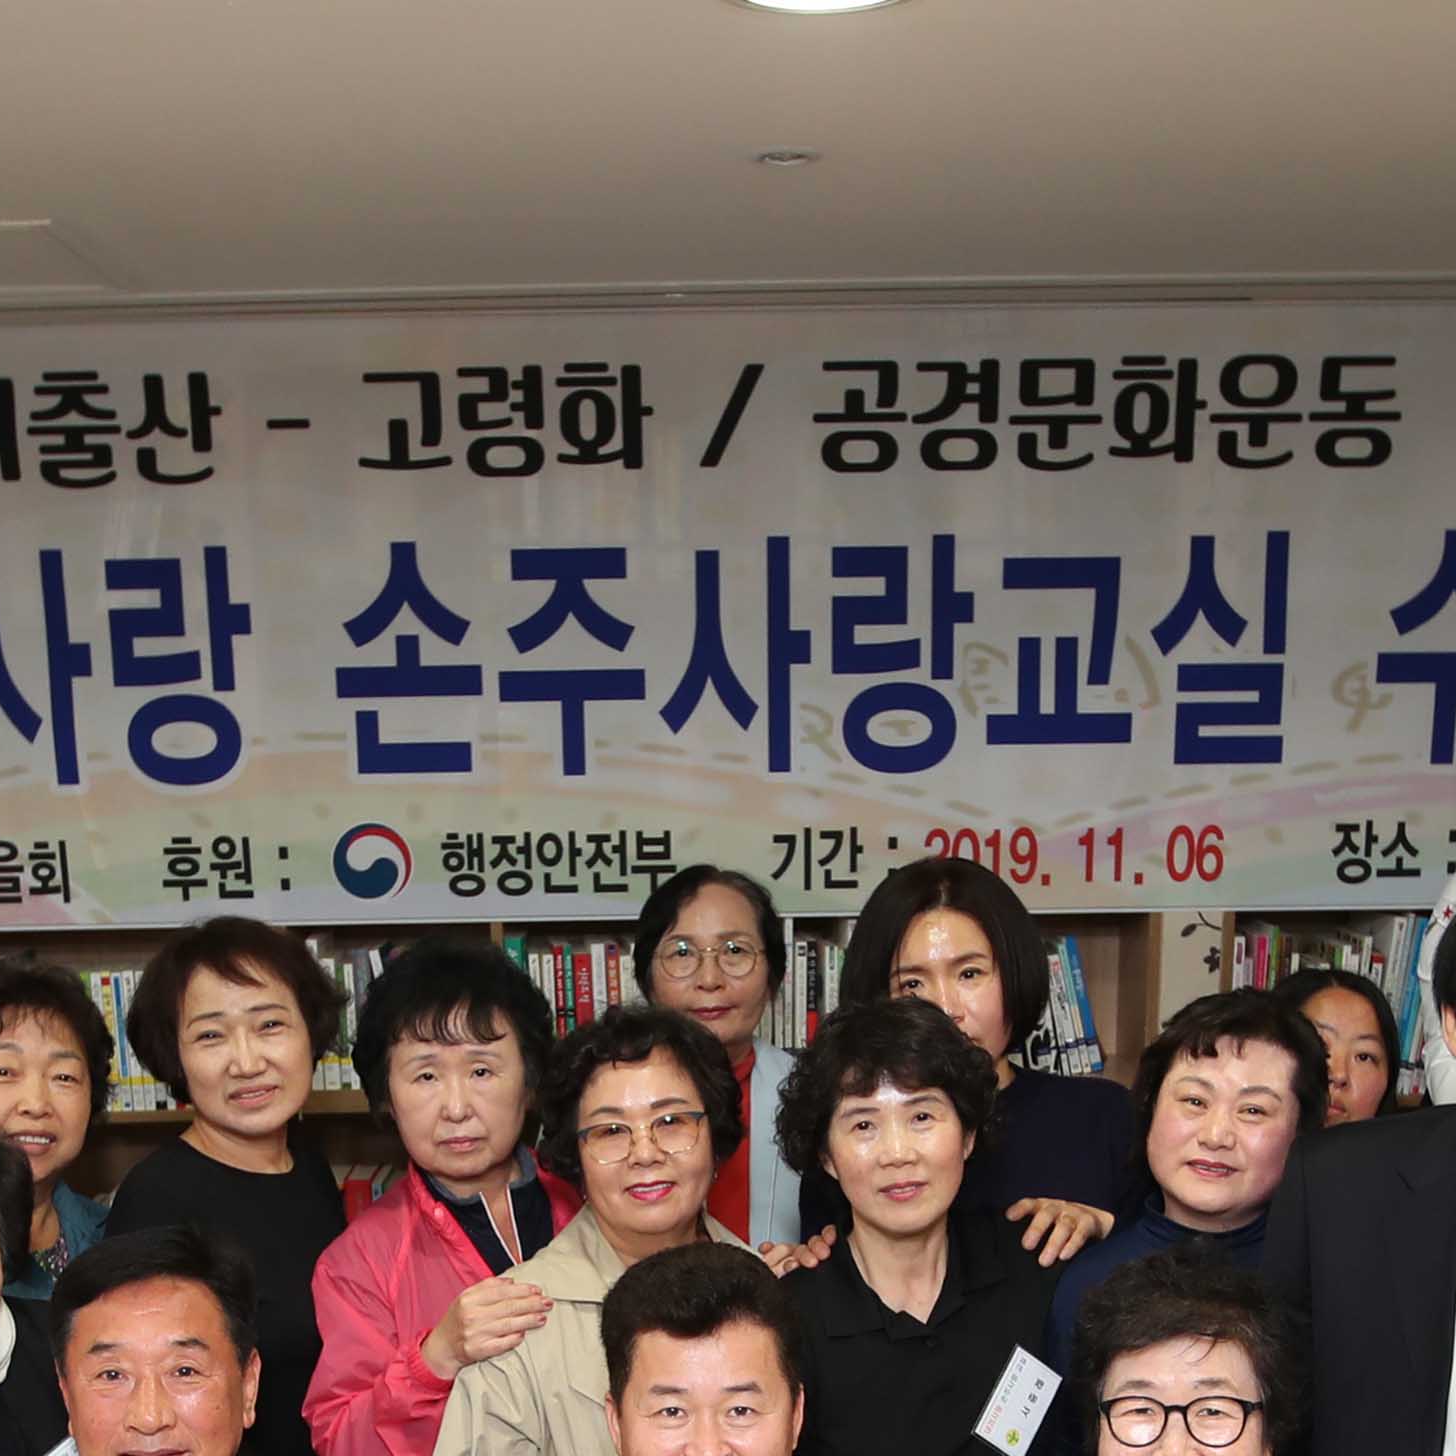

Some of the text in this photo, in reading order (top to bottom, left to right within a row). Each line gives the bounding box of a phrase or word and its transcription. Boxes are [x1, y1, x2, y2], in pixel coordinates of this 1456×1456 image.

[358, 362, 654, 478] 고령화
[812, 354, 1402, 473] 공경문화운동
[335, 530, 1290, 776] 손주사랑교실
[162, 836, 255, 901] 후원
[441, 829, 678, 898] 행정안전부
[771, 827, 865, 891] 기간
[1166, 824, 1226, 882] 06
[1331, 819, 1422, 885] 장소
